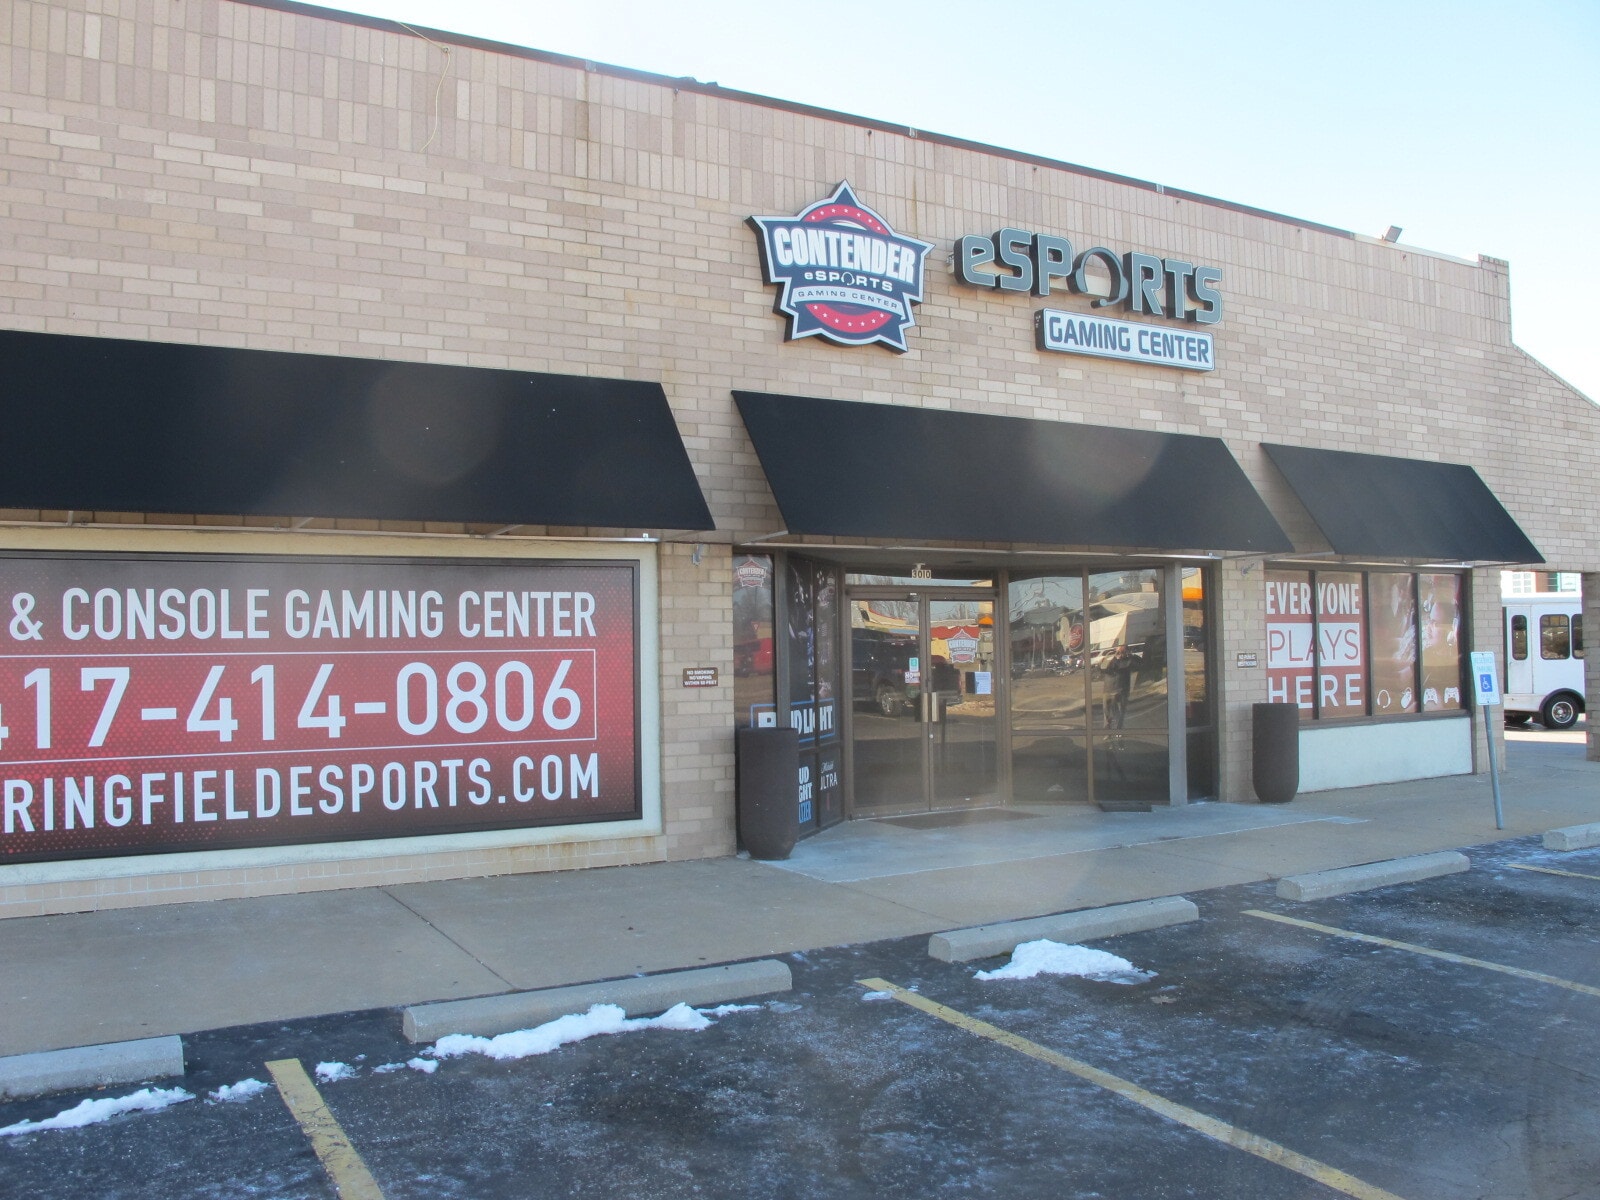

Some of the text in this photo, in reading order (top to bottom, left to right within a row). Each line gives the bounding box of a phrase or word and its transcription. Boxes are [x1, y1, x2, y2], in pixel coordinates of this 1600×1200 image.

[773, 227, 915, 285] CONTENDER
[797, 289, 898, 309] GAMING CENTER
[1048, 316, 1210, 364] GAMING CENTER
[912, 569, 931, 579] 3010
[9, 586, 597, 641] & CONSOLE GAMING CENTER
[1266, 581, 1360, 615] EVERYONE
[1268, 628, 1359, 662] PLAYS
[0, 659, 581, 750] 17-414-0806
[1268, 673, 1361, 709] HERE
[4, 752, 599, 834] RINGFIELDESPORTS.COM
